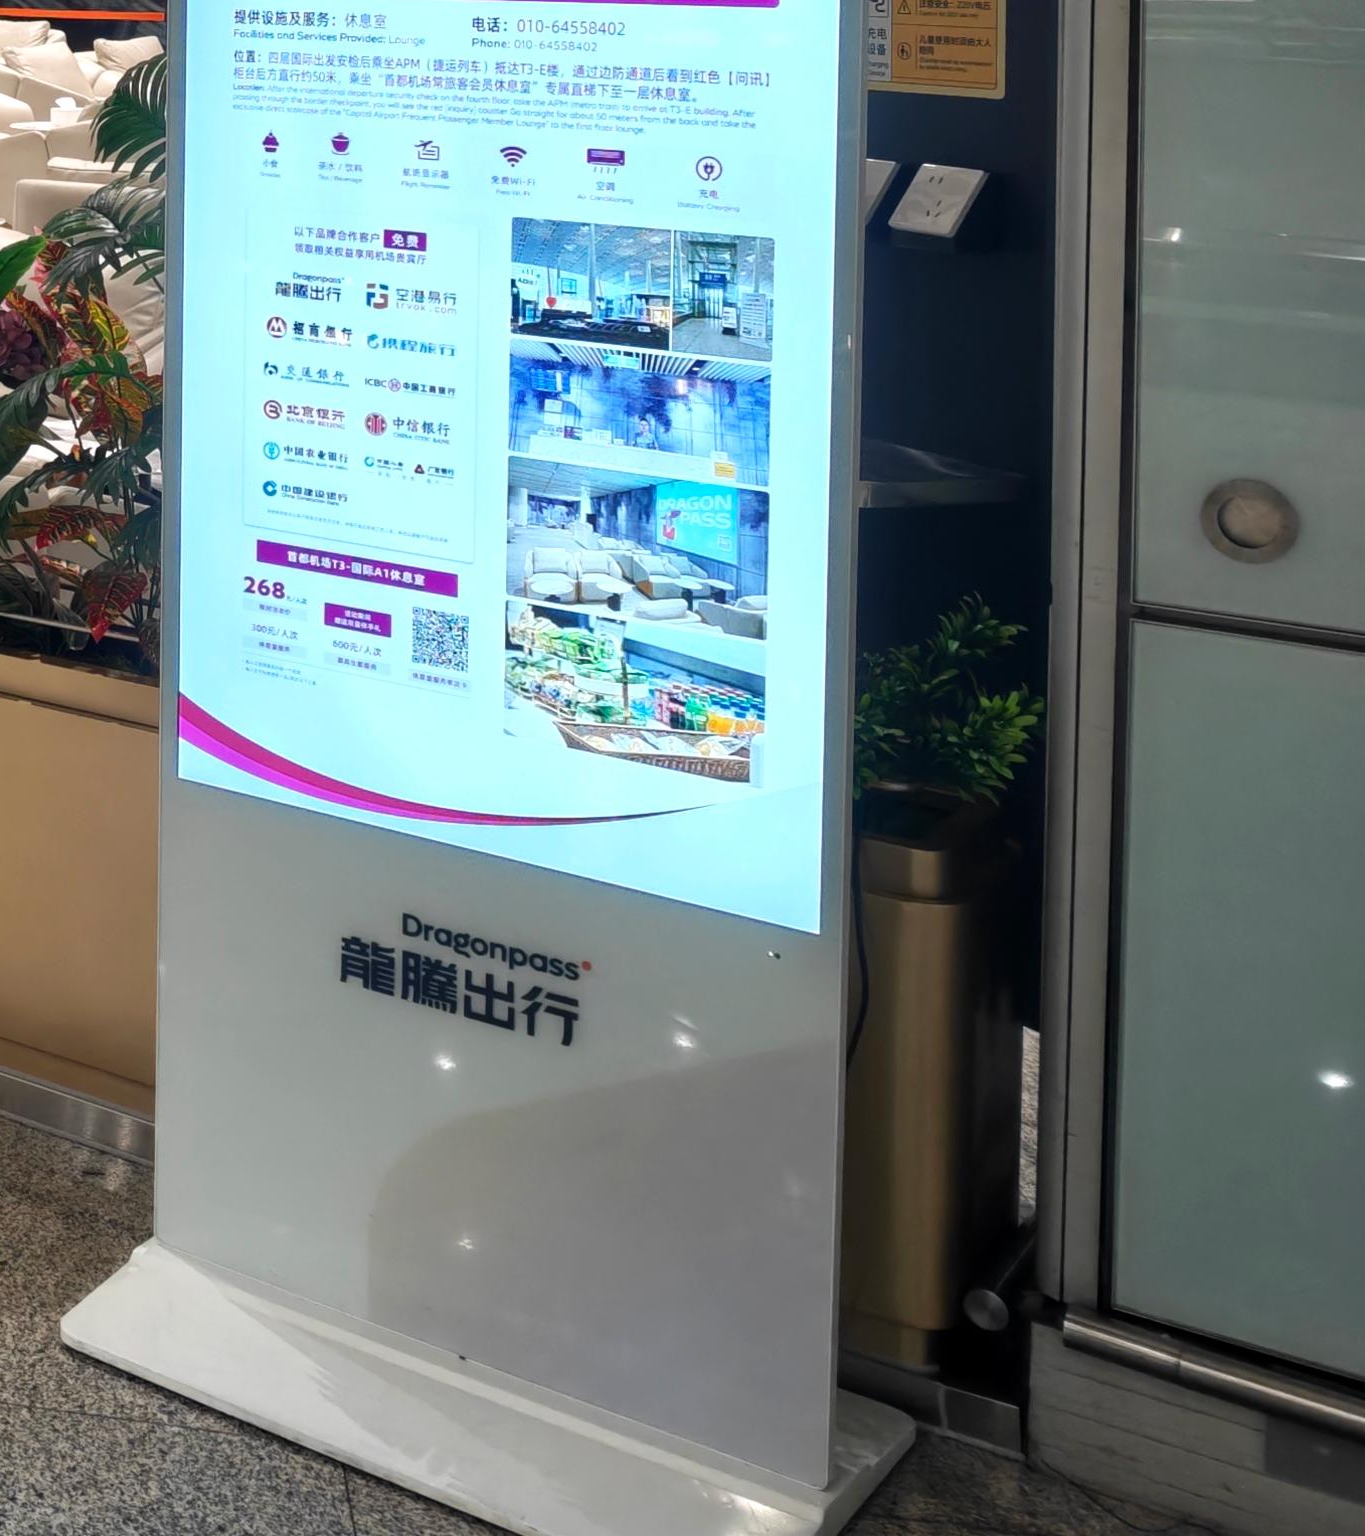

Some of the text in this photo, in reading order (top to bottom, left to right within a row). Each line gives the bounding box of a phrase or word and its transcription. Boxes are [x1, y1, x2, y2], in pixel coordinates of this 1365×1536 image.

[233, 29, 275, 40] Facilities
[277, 31, 296, 41] and
[297, 31, 338, 42] Services
[389, 35, 426, 46] Lounge
[472, 38, 598, 52] Phone: 010-64558402
[596, 181, 615, 191] 空调
[699, 189, 718, 199] 充电
[294, 226, 420, 249] 以下品牌合作客户 免费
[396, 288, 457, 306] 空港易行
[365, 377, 388, 388] ICBC
[392, 416, 451, 437] 中信银行
[243, 576, 286, 599] 268
[402, 912, 581, 982] Dragonpass
[340, 935, 580, 1047] 龍騰出行
